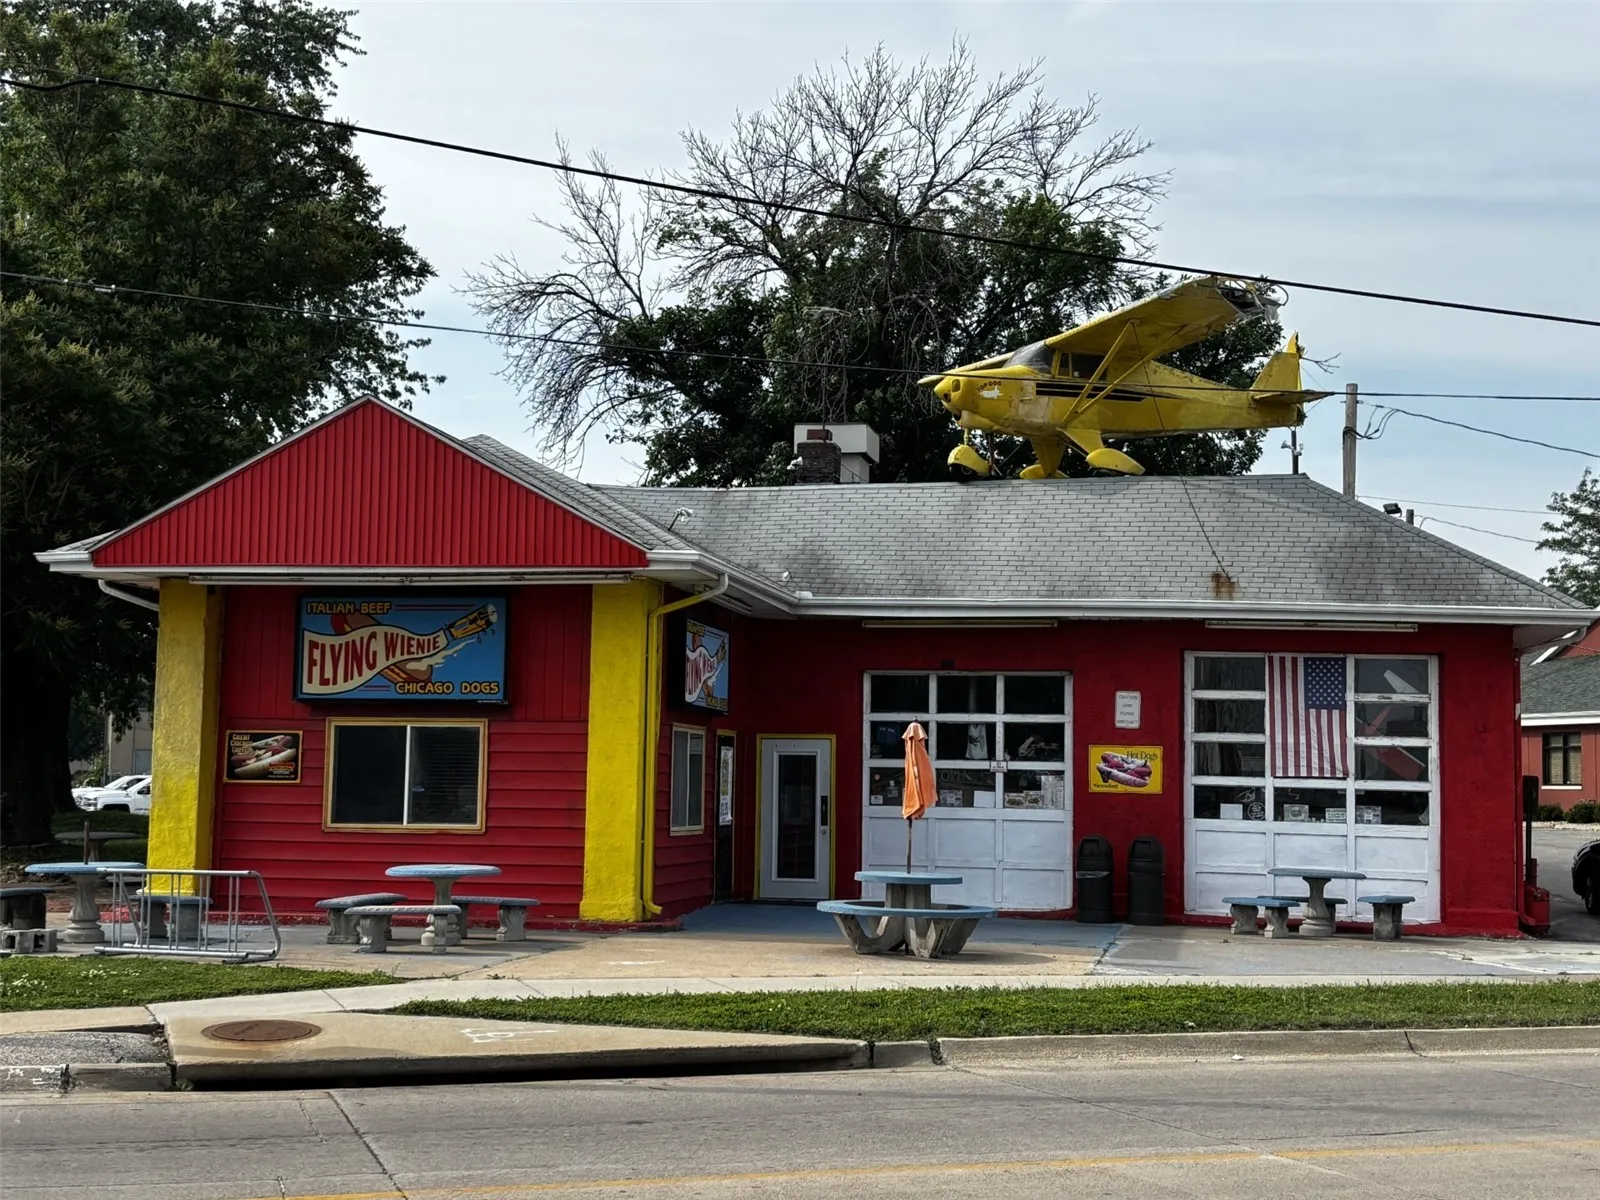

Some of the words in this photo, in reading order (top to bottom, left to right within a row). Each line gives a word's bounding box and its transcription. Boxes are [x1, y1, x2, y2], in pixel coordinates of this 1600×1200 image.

[307, 603, 355, 614] ITALIAN
[361, 603, 391, 614] BEEF
[307, 631, 377, 687] FLYING
[384, 631, 441, 662] WIENIE
[395, 682, 453, 694] CHICAGO
[461, 682, 499, 694] DOGS
[1127, 751, 1139, 759] Hot
[1141, 751, 1158, 762] Dogs
